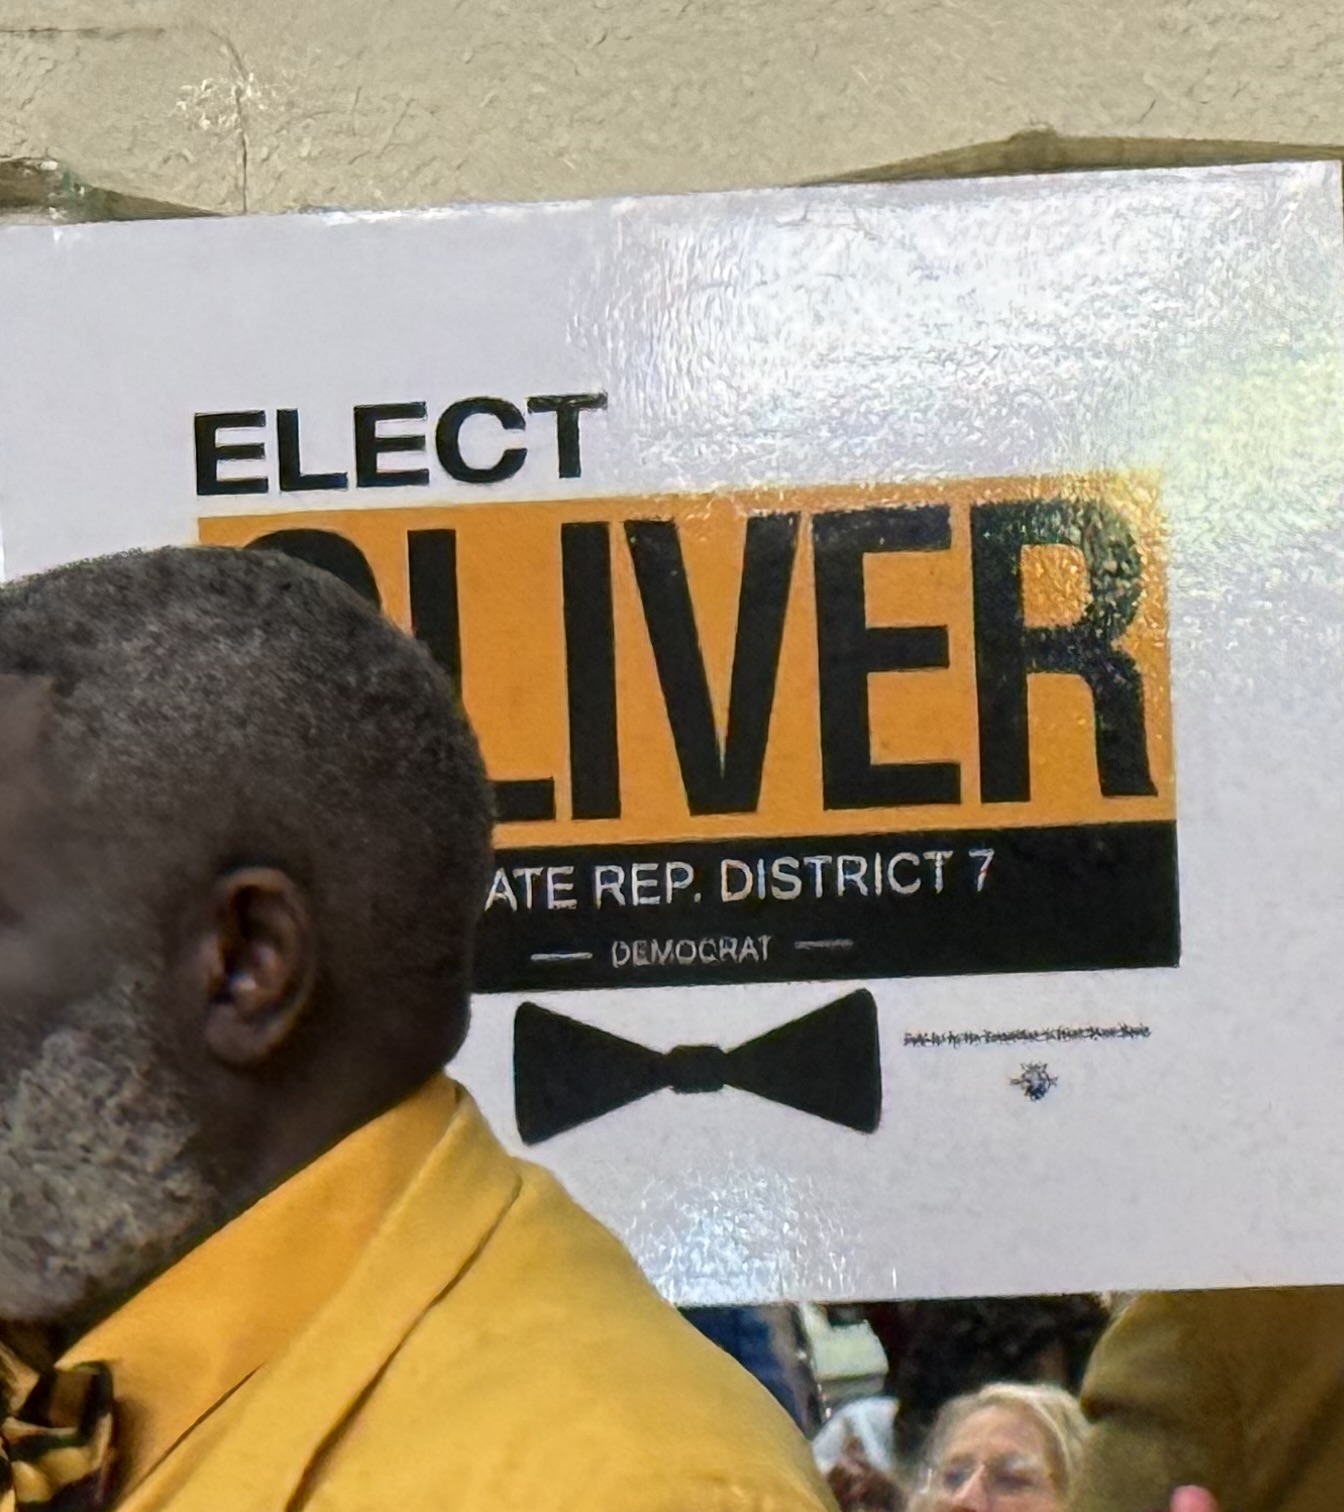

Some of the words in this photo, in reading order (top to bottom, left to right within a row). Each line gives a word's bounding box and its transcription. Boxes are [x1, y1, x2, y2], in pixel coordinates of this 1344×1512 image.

[195, 391, 608, 496] ELECT
[246, 503, 1158, 824] LIVER
[593, 860, 702, 909] REP.
[721, 850, 953, 903] DISTRICT
[968, 848, 995, 892] 7
[611, 934, 774, 967] DEMOCRAT
